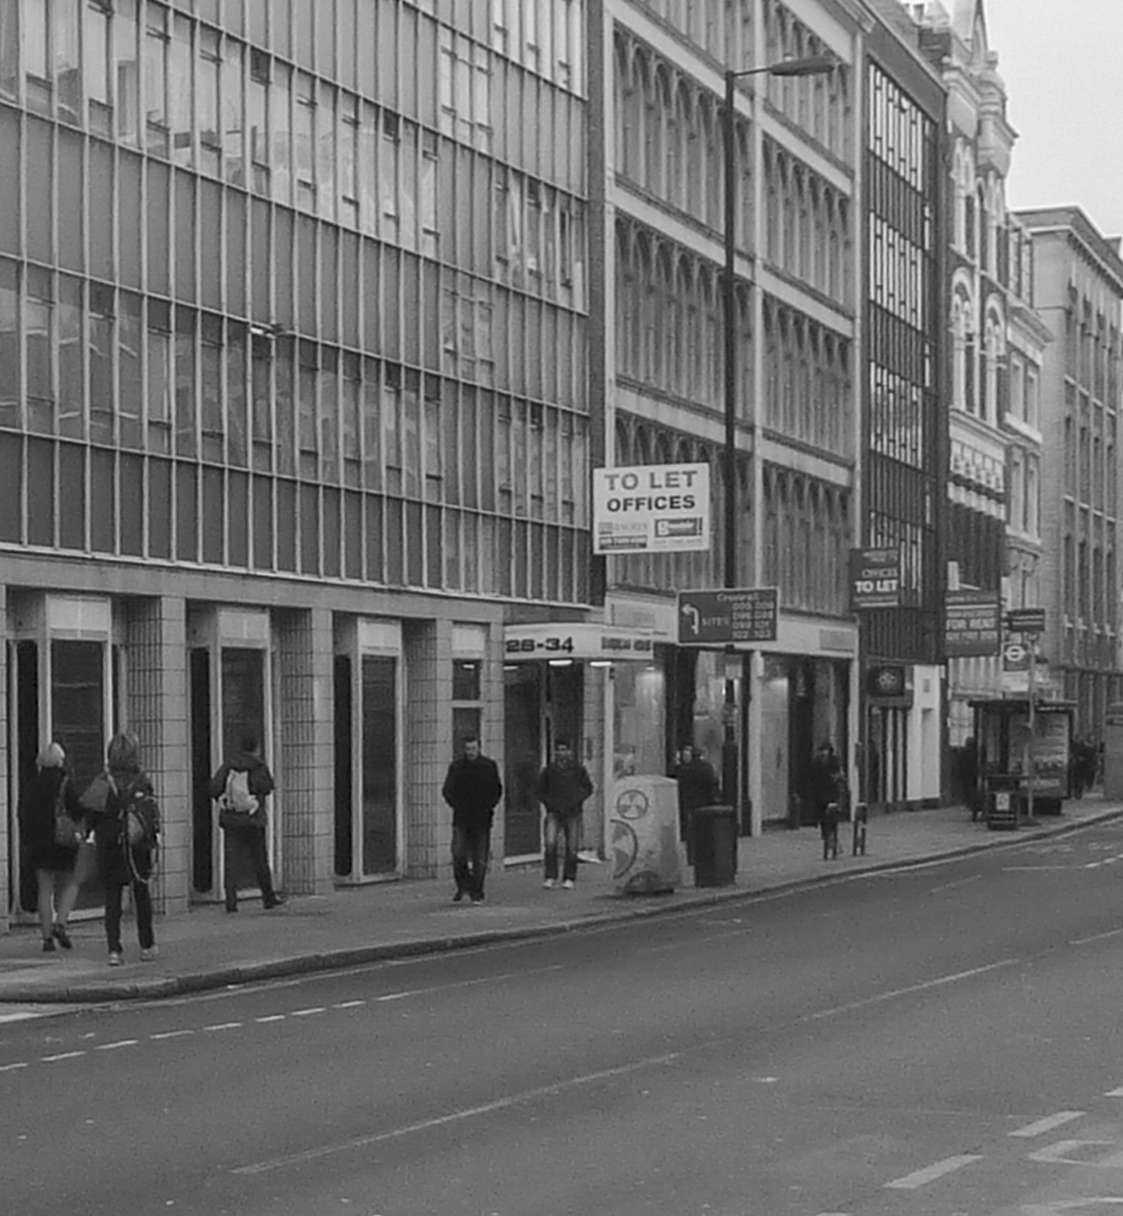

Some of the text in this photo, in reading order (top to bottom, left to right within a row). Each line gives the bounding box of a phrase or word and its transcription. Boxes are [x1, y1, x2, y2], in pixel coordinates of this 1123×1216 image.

[603, 469, 699, 492] TO LET
[606, 494, 696, 513] OFFICES
[855, 579, 899, 593] TO LET
